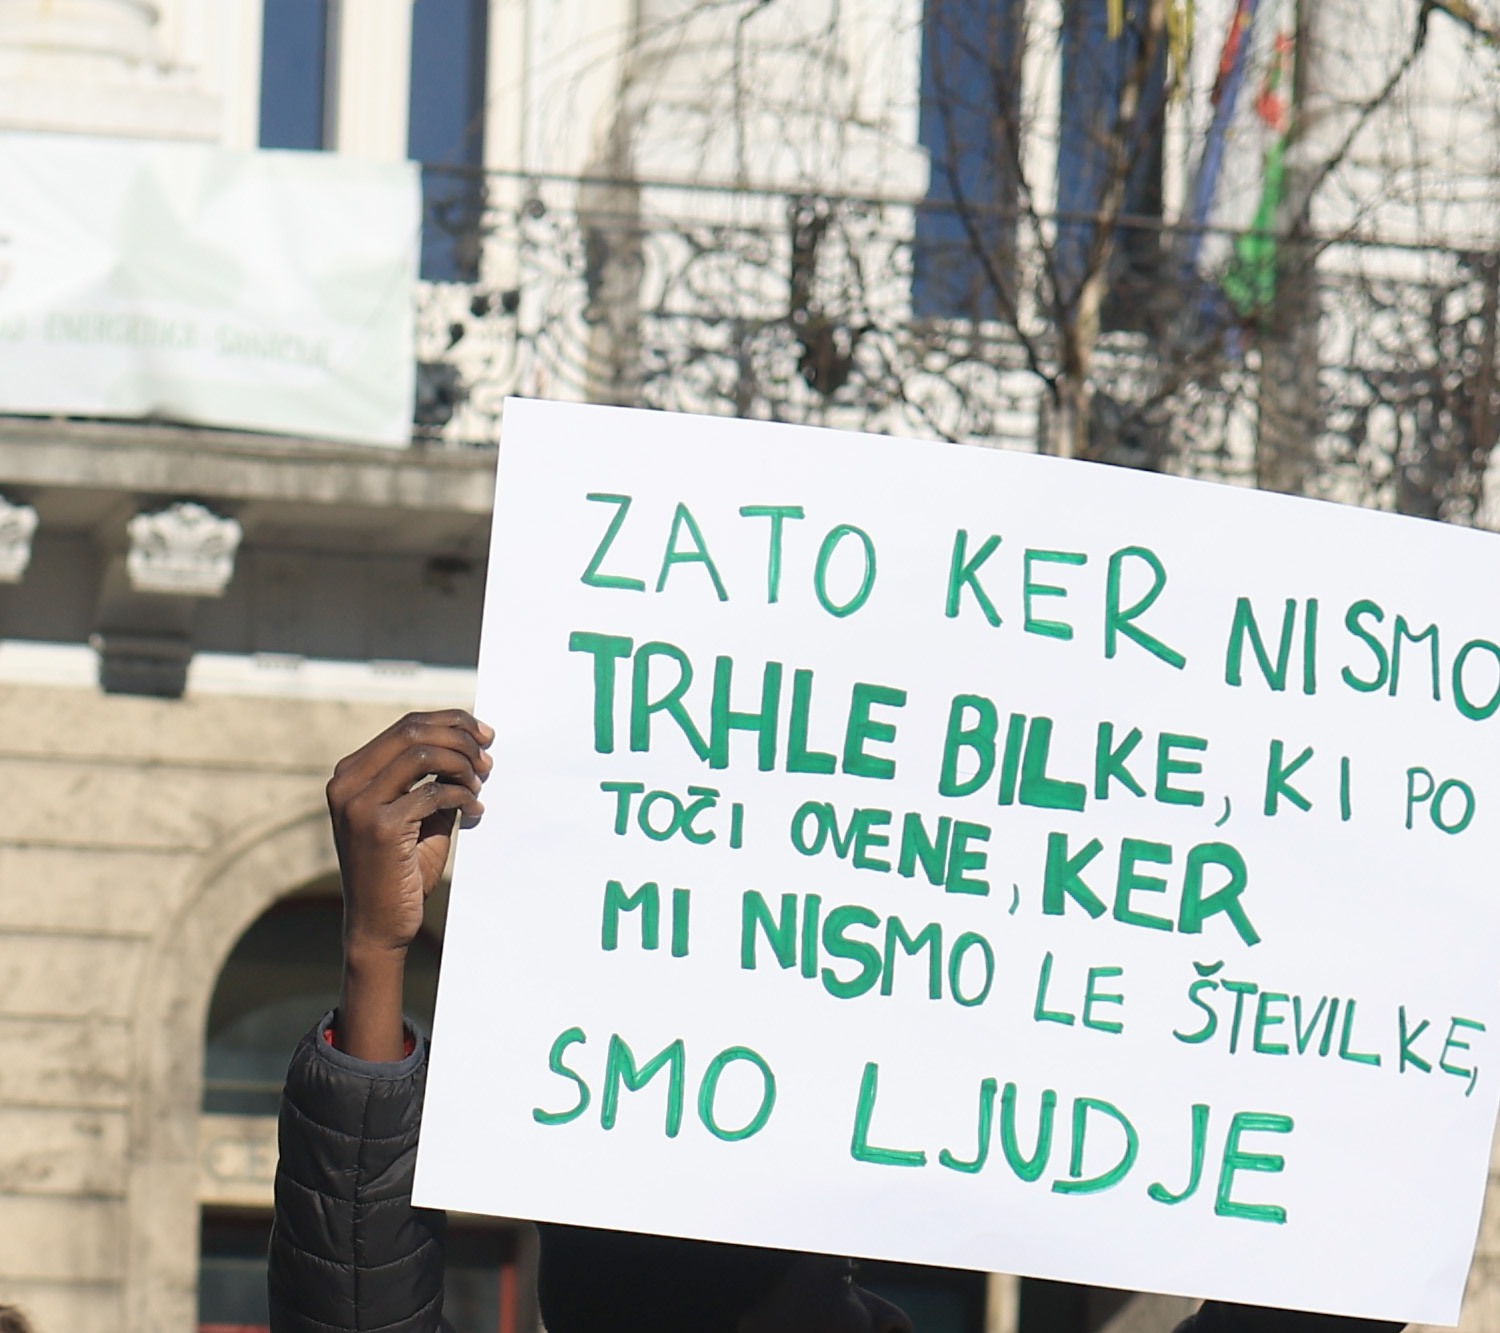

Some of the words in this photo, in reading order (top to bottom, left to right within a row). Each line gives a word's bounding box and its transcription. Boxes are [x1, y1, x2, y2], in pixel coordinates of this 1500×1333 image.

[580, 493, 877, 618] ZATO
[945, 529, 1186, 670] KER
[568, 631, 907, 780] TRHLE
[938, 694, 1231, 827] BILKE,
[1264, 739, 1352, 822] KI
[1405, 766, 1476, 835] PO
[600, 781, 744, 849] TOČI
[1042, 832, 1261, 947] KER
[601, 880, 691, 958] MI
[741, 890, 995, 1007] NISMO
[1034, 951, 1124, 1035] LE
[1172, 960, 1486, 1097] ŠTEVILKE,
[532, 1027, 777, 1142] SMO
[850, 1062, 1294, 1225] LJUDJE
